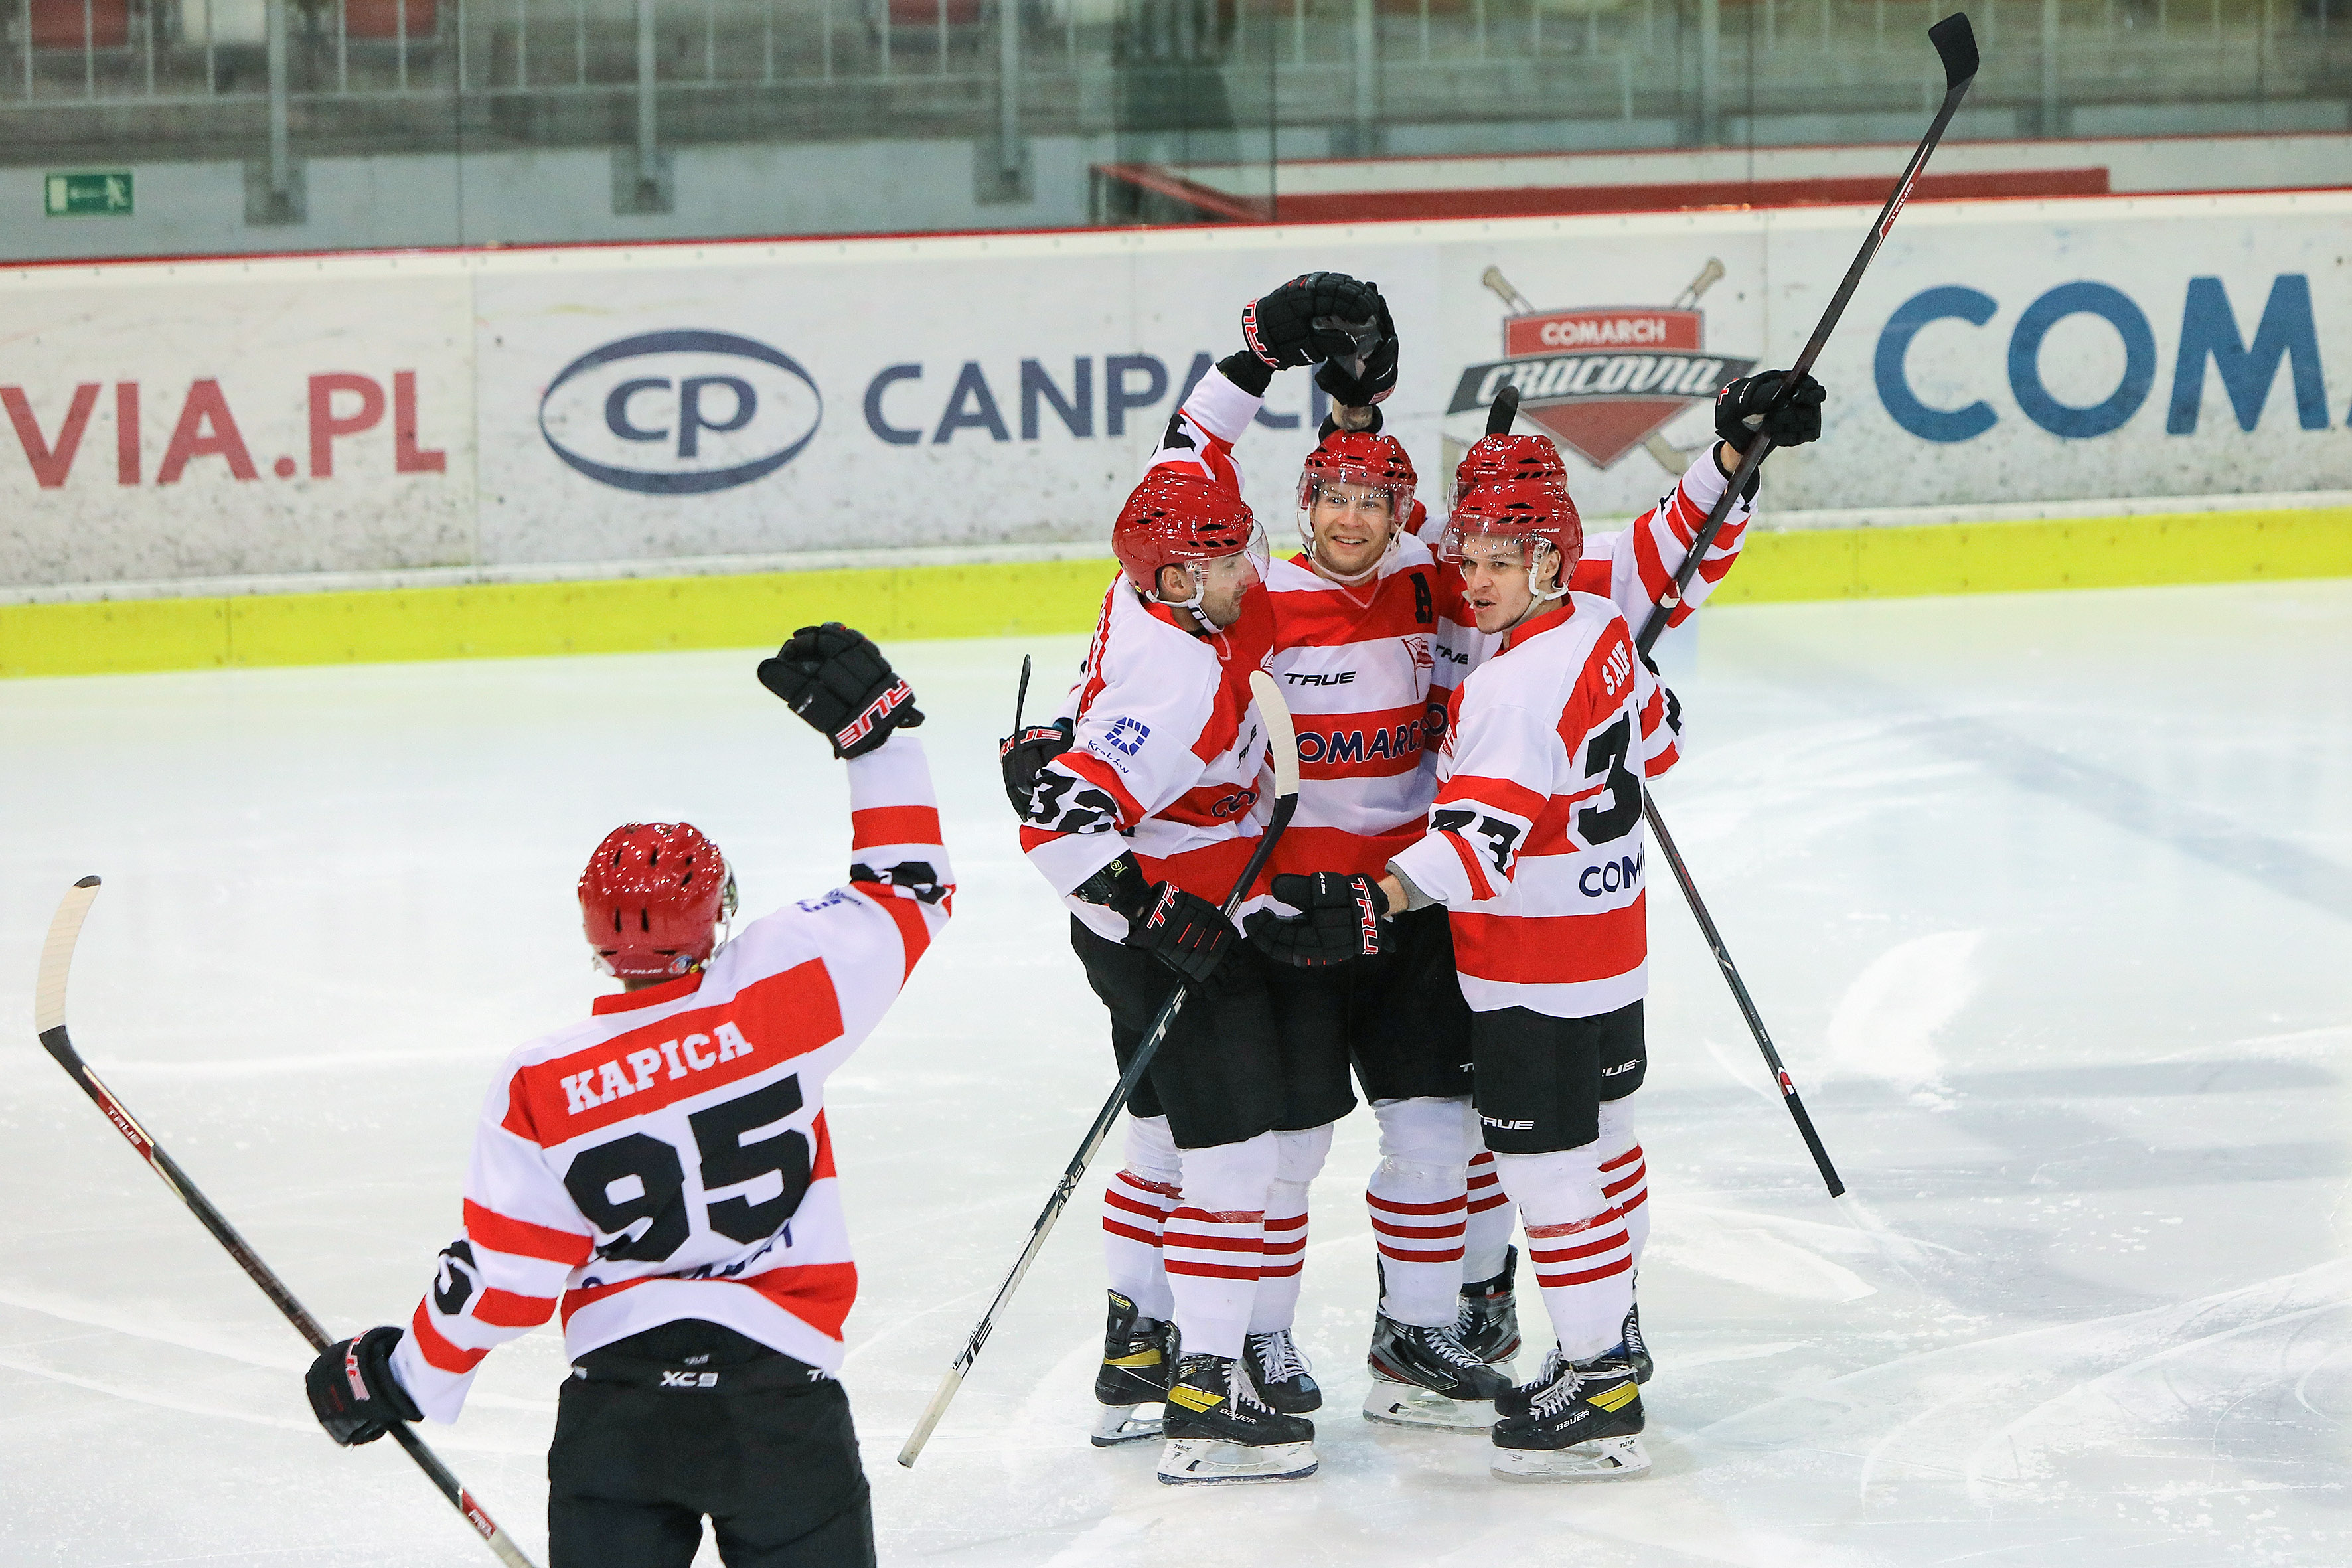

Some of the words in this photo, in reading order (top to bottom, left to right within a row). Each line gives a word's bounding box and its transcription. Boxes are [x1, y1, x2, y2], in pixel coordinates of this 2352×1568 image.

[1889, 182, 1914, 222] TRUE
[1241, 297, 1280, 369] TRU
[1540, 319, 1666, 346] COMARCH
[1874, 273, 2352, 443] COM
[862, 349, 1326, 446] CANP
[0, 369, 447, 490] VIA.PL
[1409, 572, 1433, 624] A
[1283, 670, 1357, 687] TRUE
[836, 676, 913, 751] RUE
[1000, 728, 1063, 765] RUE
[1087, 739, 1129, 775] Kraków
[1266, 718, 1426, 765] OMARC
[1577, 700, 1645, 846] 3
[1579, 842, 1646, 898] COM
[1146, 880, 1180, 929] TR
[1350, 876, 1379, 955] TRU
[560, 1020, 754, 1117] KAPICA
[1601, 1058, 1643, 1077] UE
[106, 1105, 143, 1146] TRUE
[1482, 1116, 1535, 1131] RUE
[563, 1071, 810, 1263] 95
[659, 1370, 719, 1387] XC9
